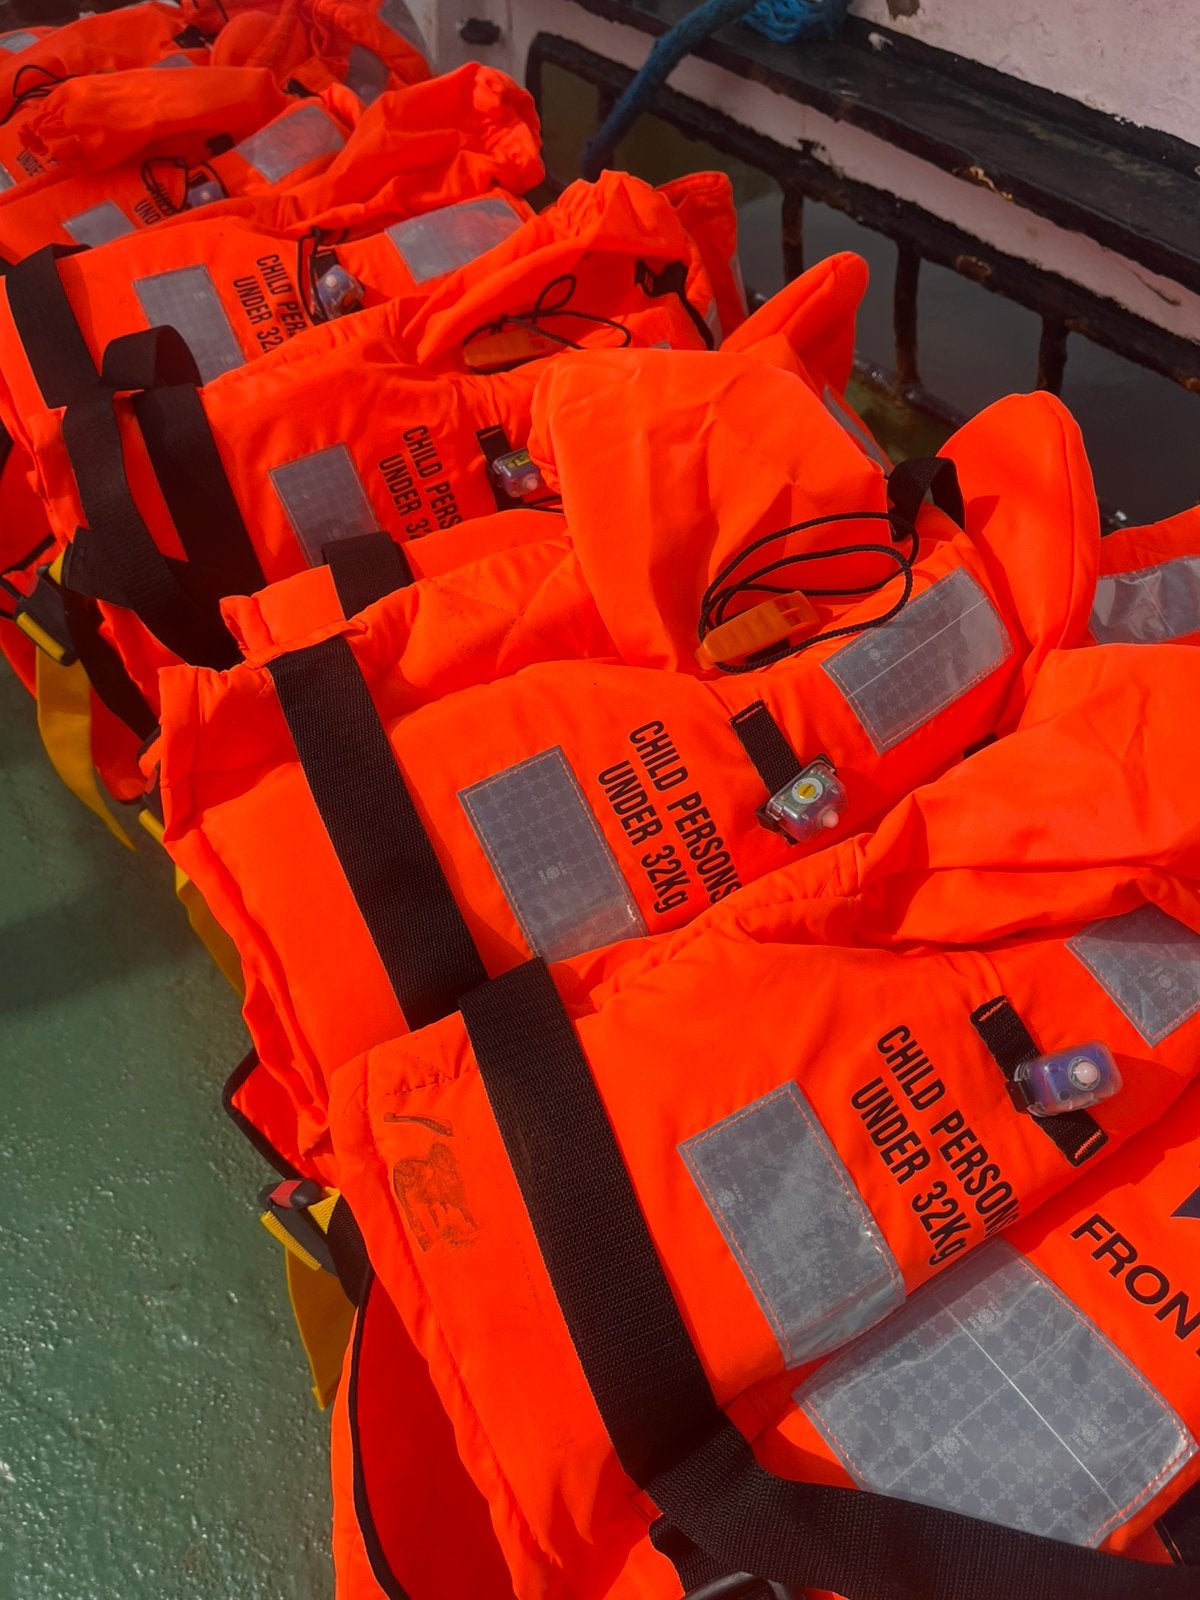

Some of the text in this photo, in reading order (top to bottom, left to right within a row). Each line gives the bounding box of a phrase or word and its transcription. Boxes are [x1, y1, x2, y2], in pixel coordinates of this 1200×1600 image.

[233, 275, 273, 325] UNDER
[256, 254, 293, 296] CHILD
[378, 453, 422, 517] UNDER
[402, 425, 443, 478] CHILD
[597, 760, 692, 914] UNDER 32Kg
[629, 720, 743, 904] CHILD PERSONS
[876, 1024, 946, 1112] CHILD
[850, 1076, 973, 1267] UNDER 32Kg
[1070, 1213, 1200, 1358] FRON
